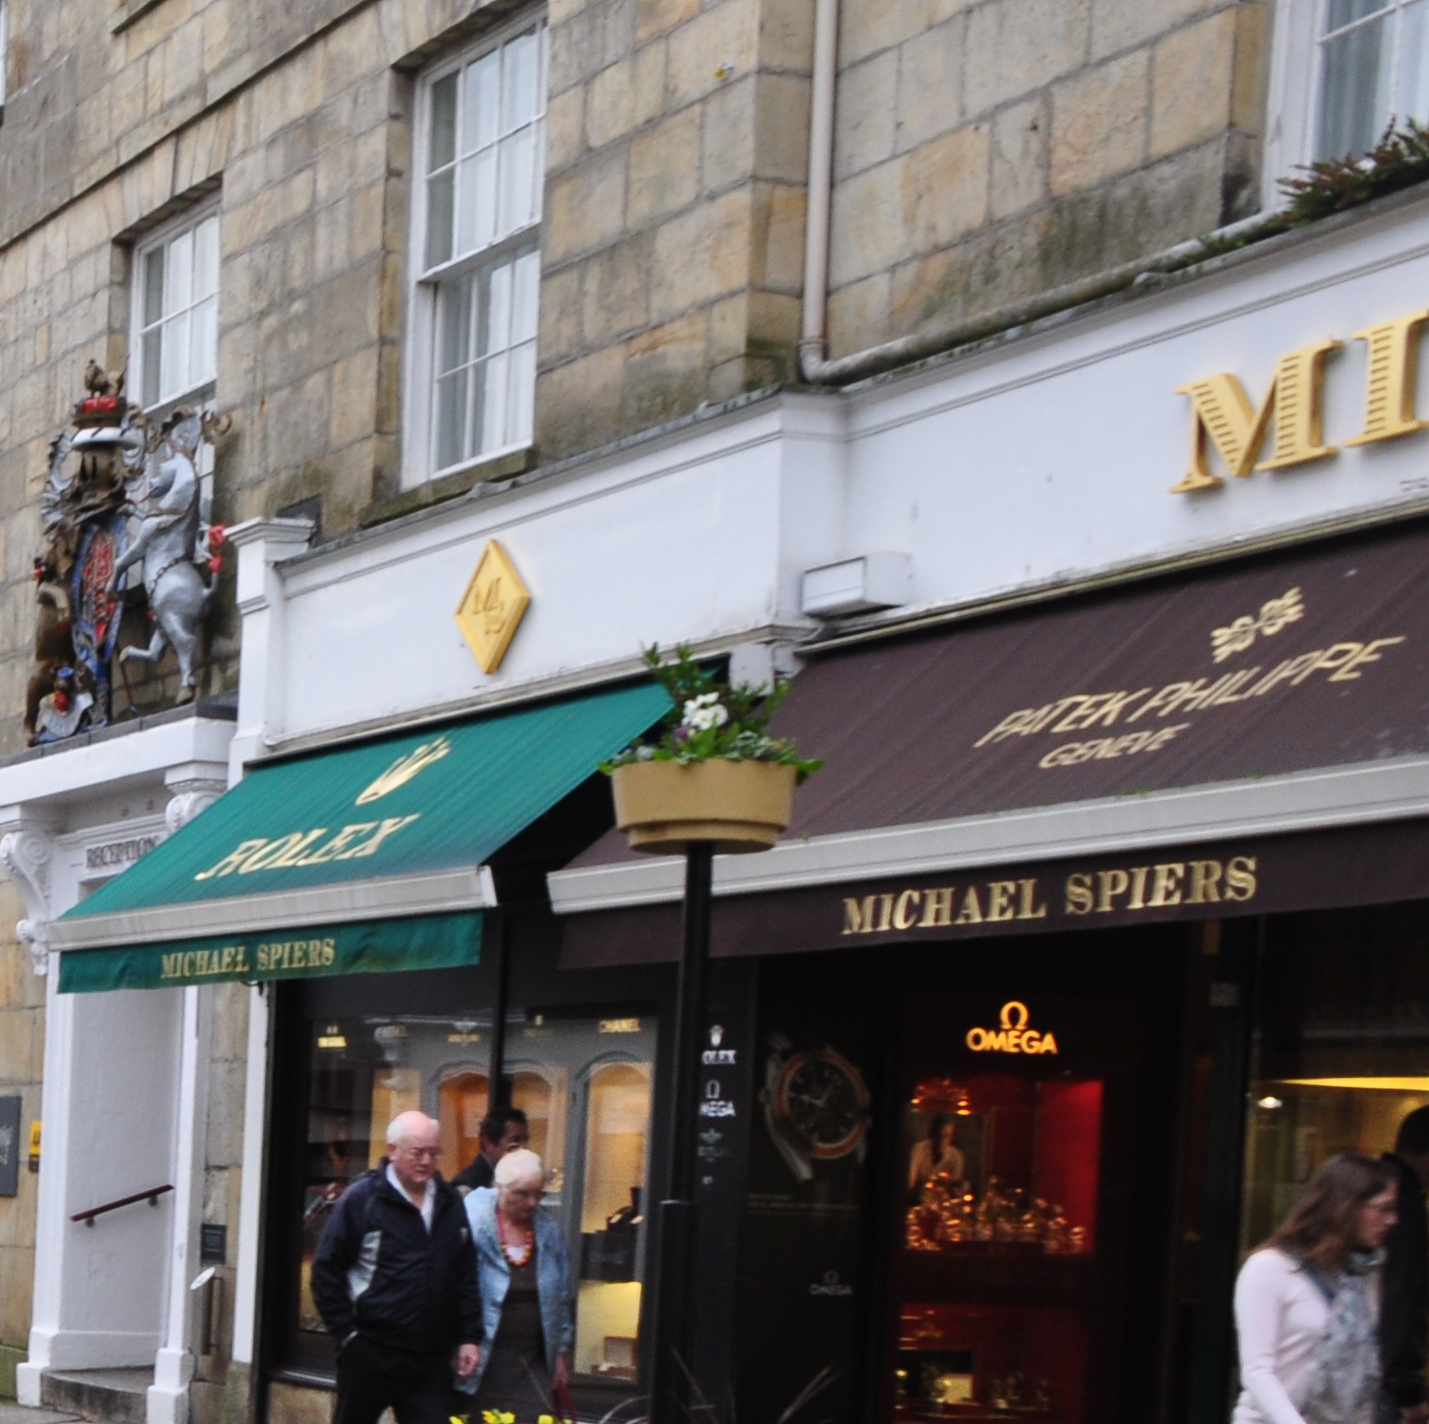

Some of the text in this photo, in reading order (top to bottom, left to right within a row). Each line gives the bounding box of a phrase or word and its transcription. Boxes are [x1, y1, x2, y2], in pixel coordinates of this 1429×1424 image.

[1170, 309, 1429, 493] MI
[973, 636, 1405, 748] PATEK PHILIPPE
[1038, 723, 1191, 769] GENEVE
[194, 813, 421, 881] ROLEX
[842, 856, 1258, 936] MICHAEL SPIERS
[161, 938, 336, 979] MICHAEL SPIERS
[701, 1050, 737, 1065] OLEX
[966, 1027, 1058, 1054] OMEGA
[699, 1101, 736, 1117] MEGA
